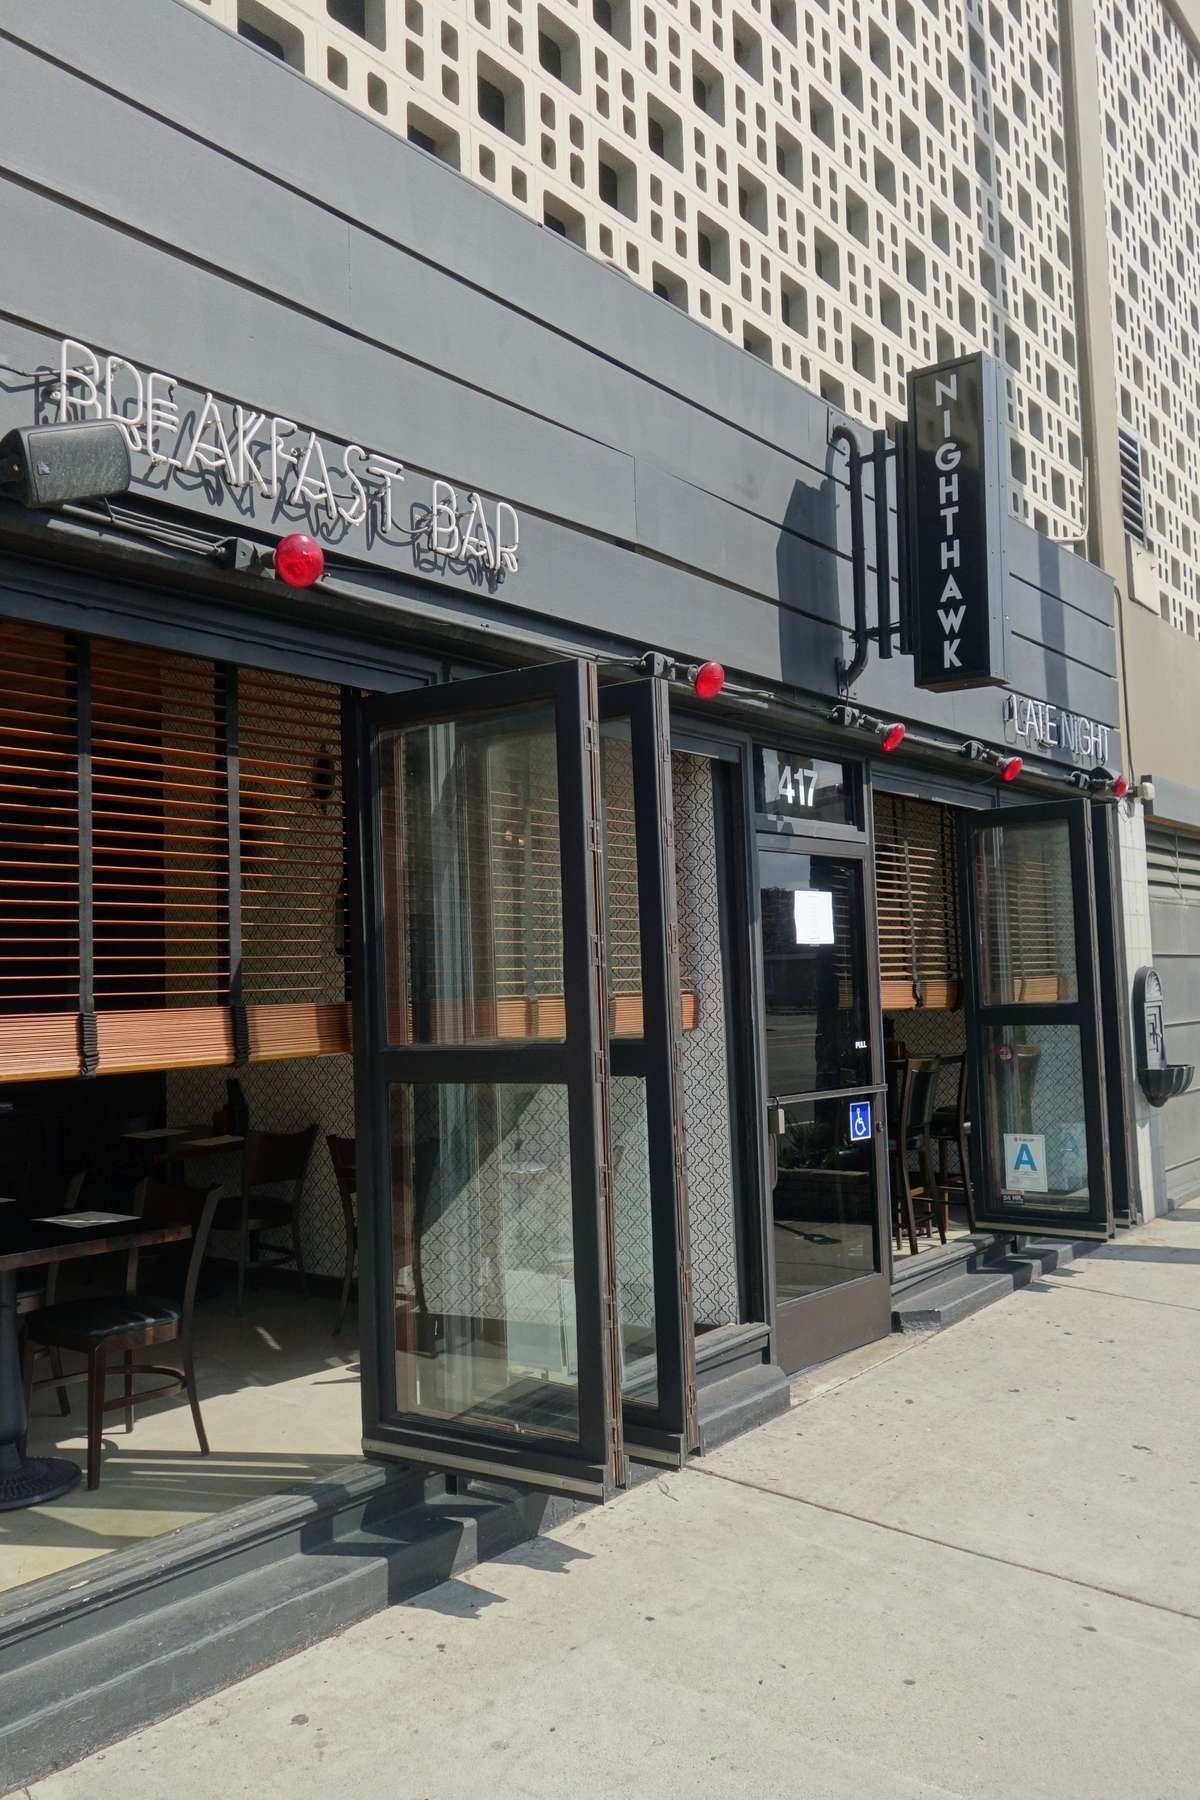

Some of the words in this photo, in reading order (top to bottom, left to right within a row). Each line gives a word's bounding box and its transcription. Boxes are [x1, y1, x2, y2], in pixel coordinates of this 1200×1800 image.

[61, 339, 405, 533] BREAKFAST
[431, 480, 519, 573] BAR
[935, 374, 967, 669] NIGHTHAWK
[1008, 694, 1058, 746] LATE
[1059, 710, 1111, 761] NIGHT
[778, 765, 819, 808] 417
[855, 1040, 868, 1049] PULL
[1013, 1142, 1038, 1172] A
